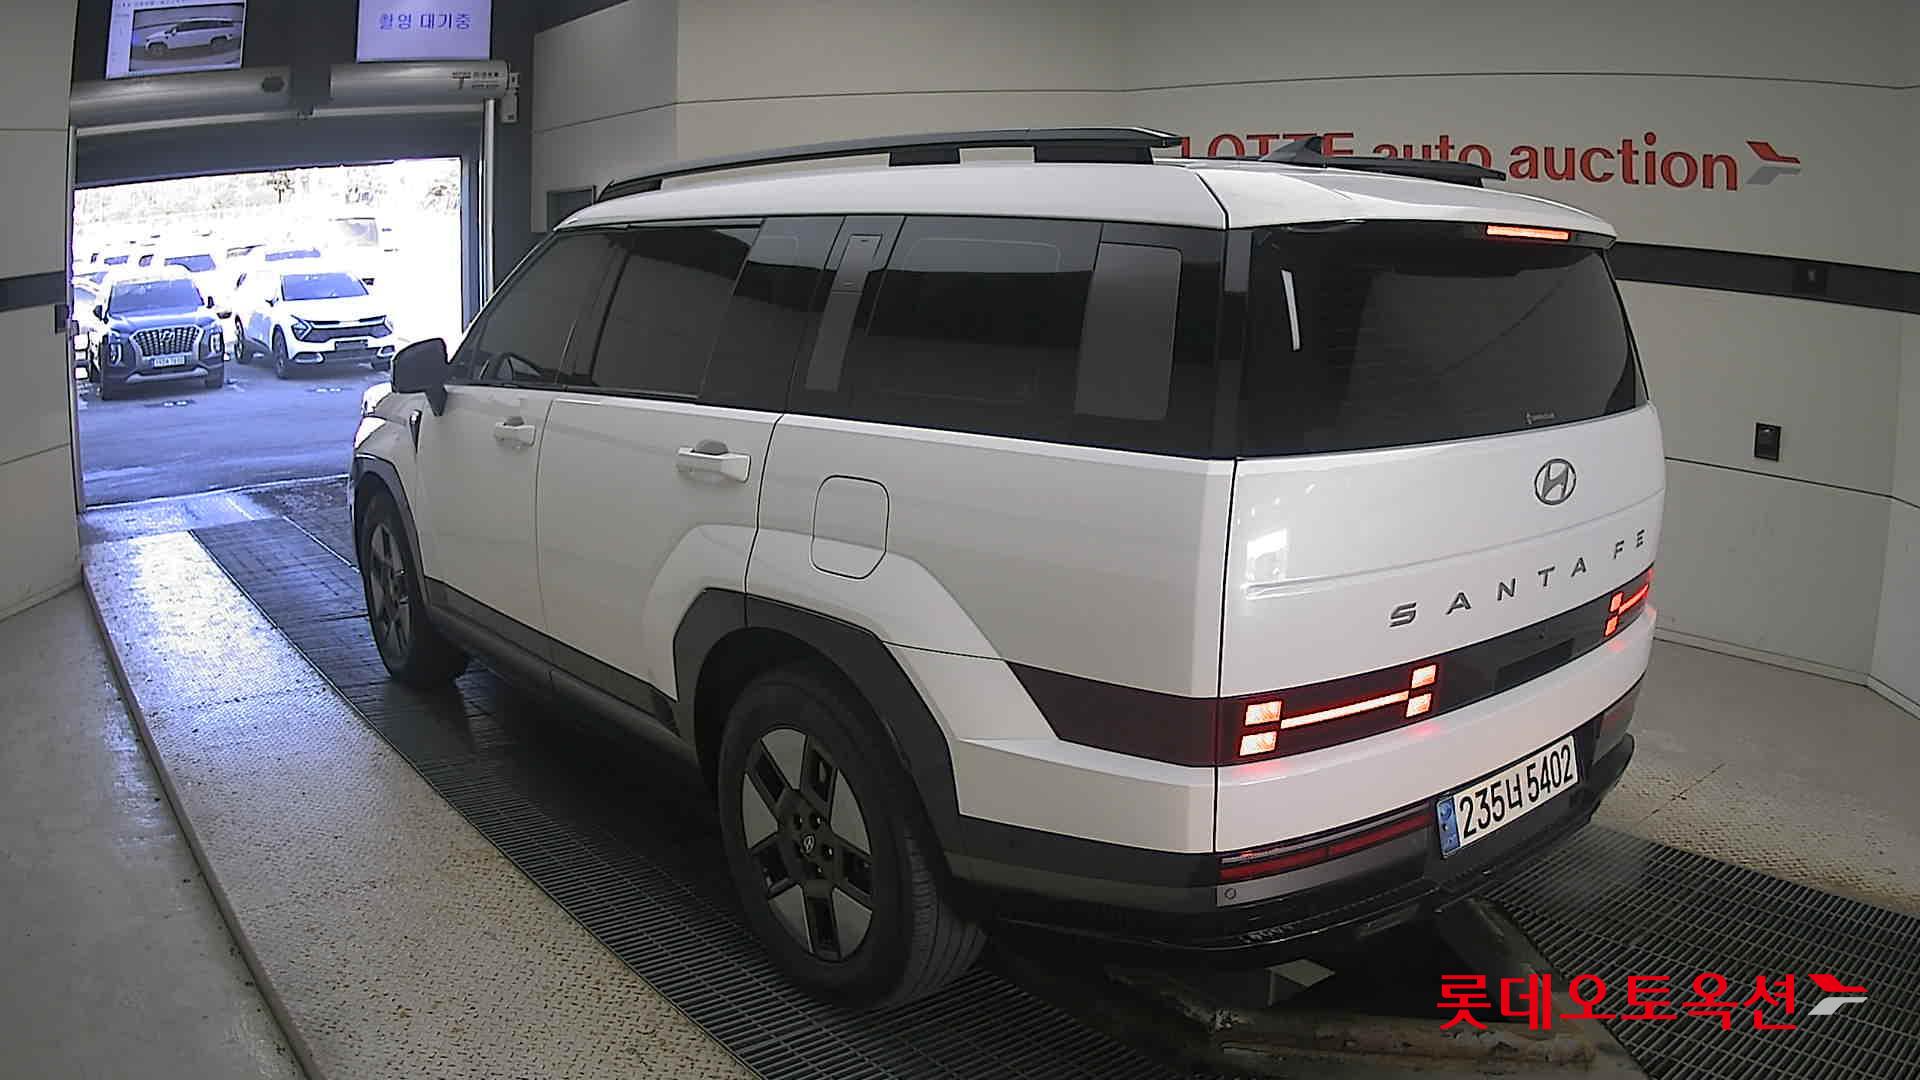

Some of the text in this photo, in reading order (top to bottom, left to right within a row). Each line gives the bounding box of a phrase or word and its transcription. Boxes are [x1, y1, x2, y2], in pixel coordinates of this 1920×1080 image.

[420, 13, 472, 30] 대기중
[1509, 131, 1738, 191] auction
[1388, 528, 1646, 628] SANTA FE
[1459, 744, 1573, 839] 235너 5402
